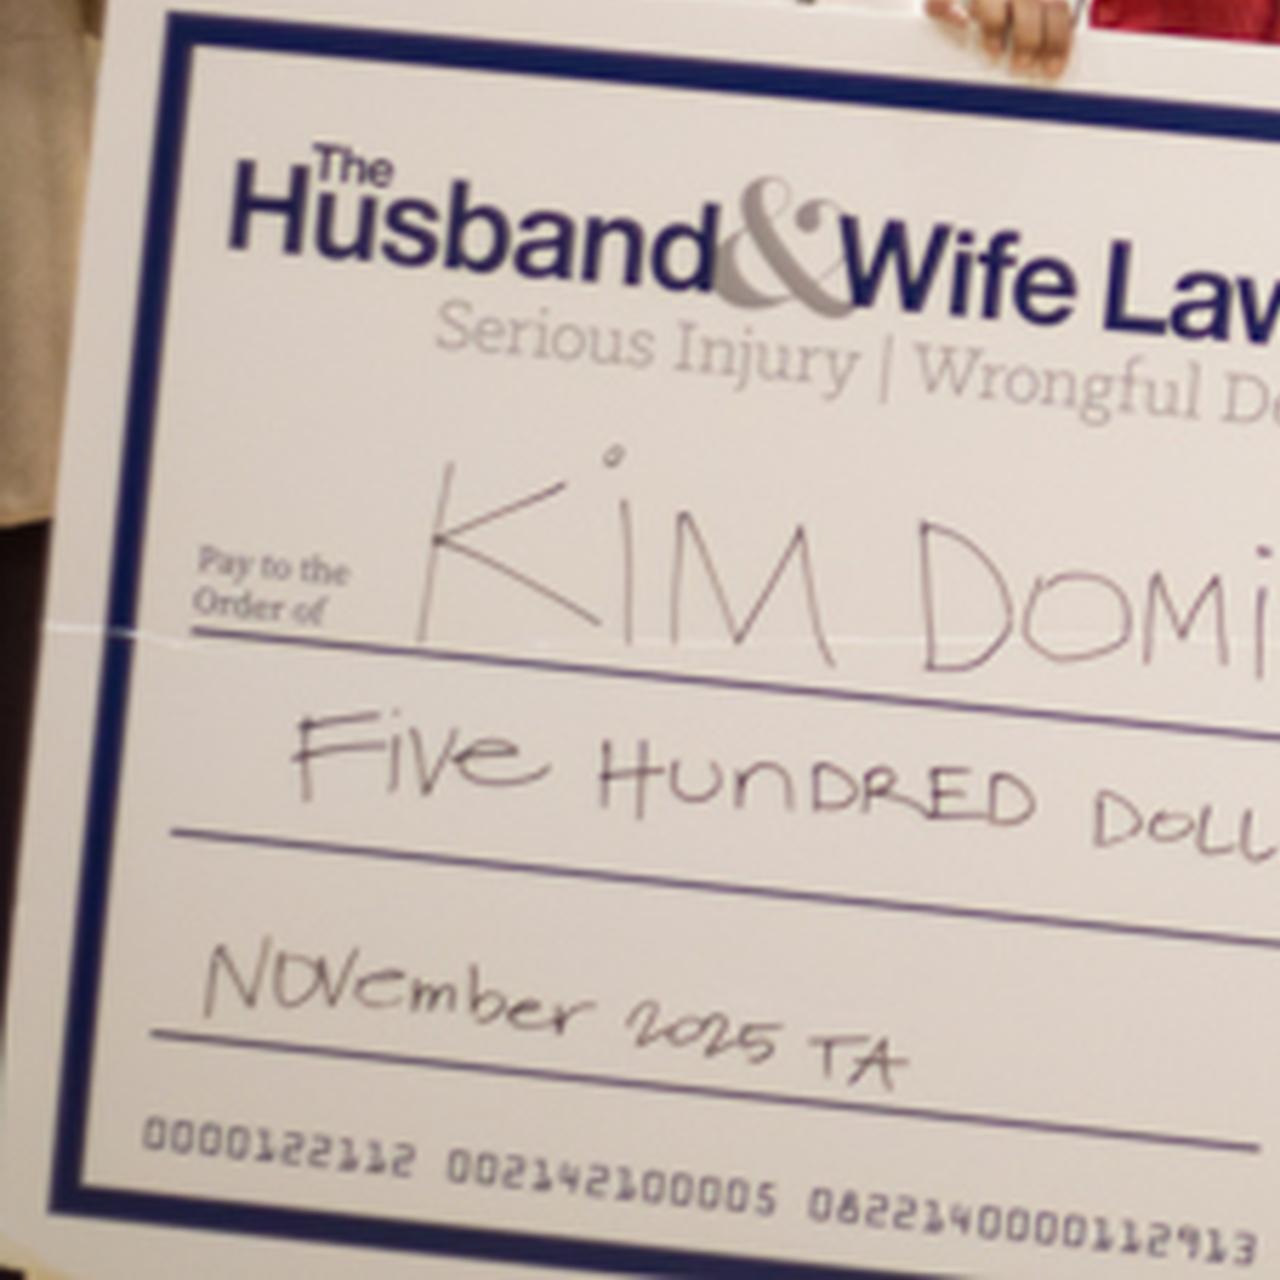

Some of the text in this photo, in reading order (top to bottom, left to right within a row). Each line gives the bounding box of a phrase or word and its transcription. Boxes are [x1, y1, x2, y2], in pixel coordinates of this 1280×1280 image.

[313, 143, 395, 188] The
[227, 158, 721, 294] Husband
[712, 175, 857, 319] &
[838, 214, 1078, 328] Wife
[434, 299, 655, 372] Serious
[673, 320, 861, 401] Injury
[915, 342, 1200, 427] Wrongful
[192, 585, 330, 627] Order of
[198, 543, 352, 587] Pay to the
[624, 995, 784, 1064] 2025
[808, 1033, 912, 1093] TA
[141, 1114, 1261, 1269] 0000122112 002142100005 0822140000112913
